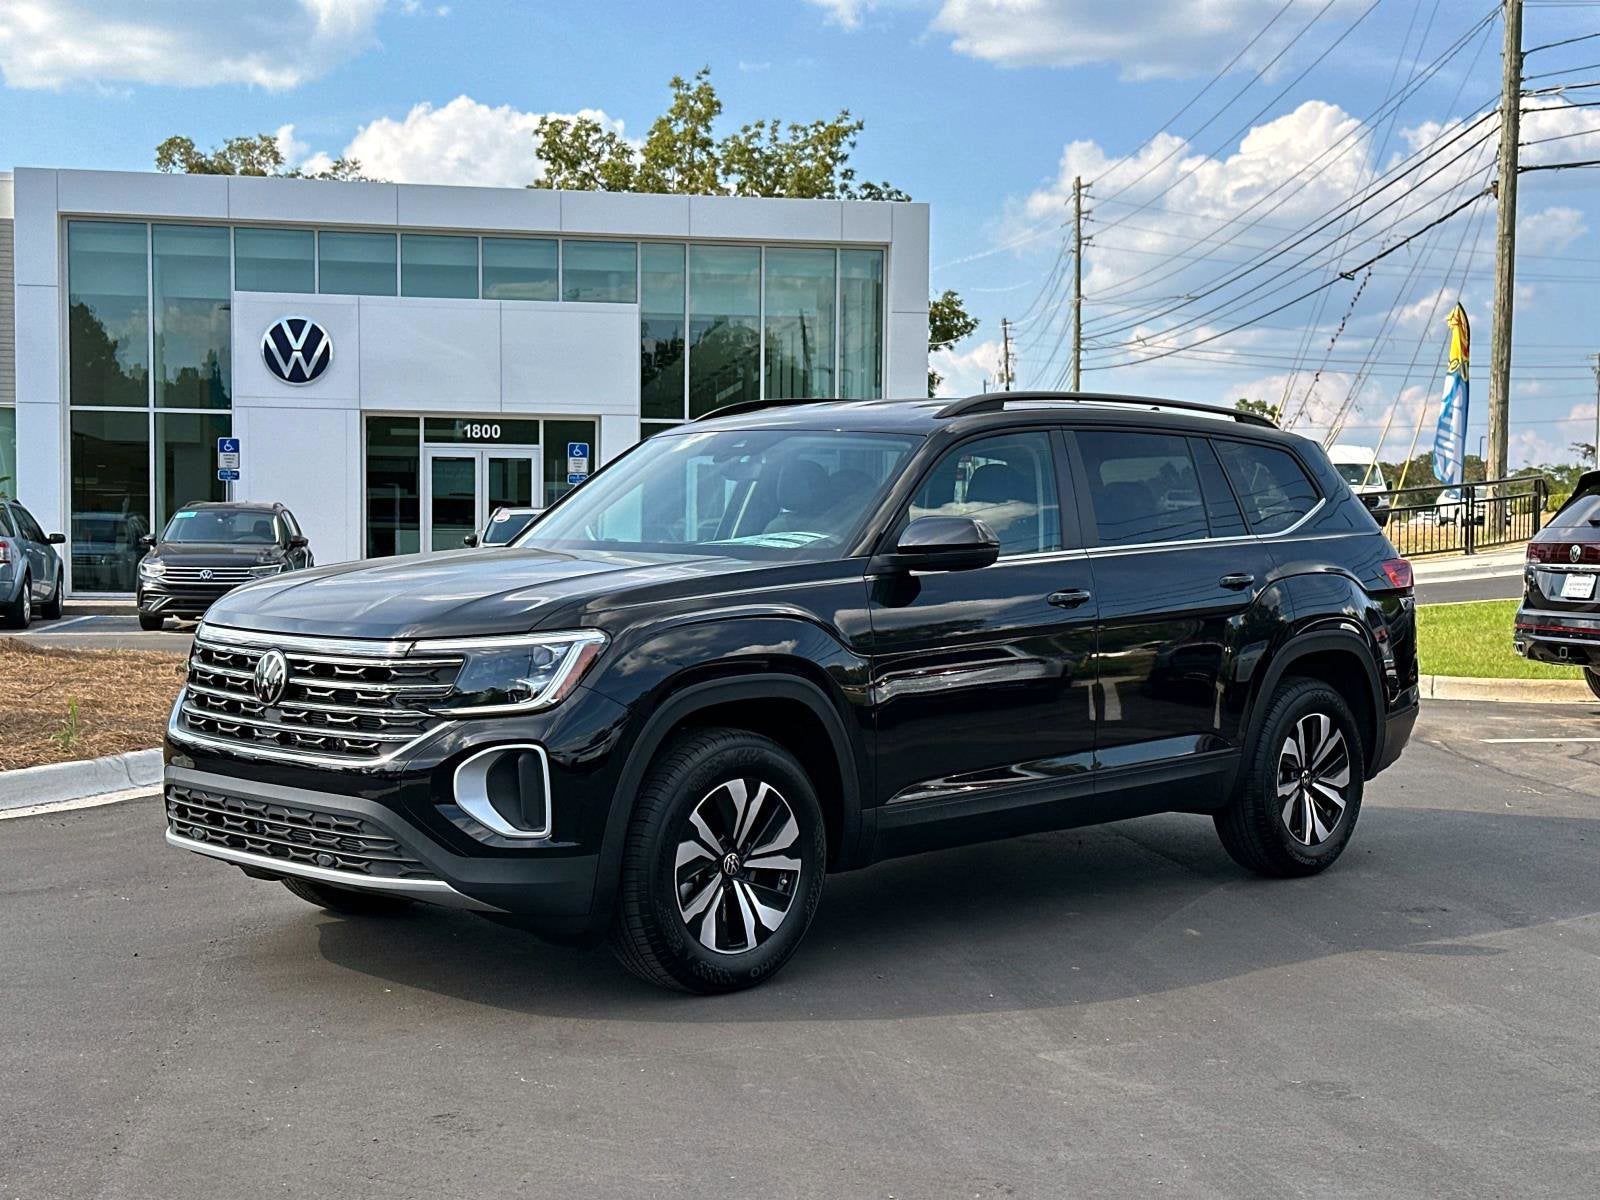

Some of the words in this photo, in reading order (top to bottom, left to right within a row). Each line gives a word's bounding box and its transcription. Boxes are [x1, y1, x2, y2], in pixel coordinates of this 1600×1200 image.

[261, 316, 333, 385] VW
[464, 424, 501, 438] 1800
[254, 649, 287, 703] VW
